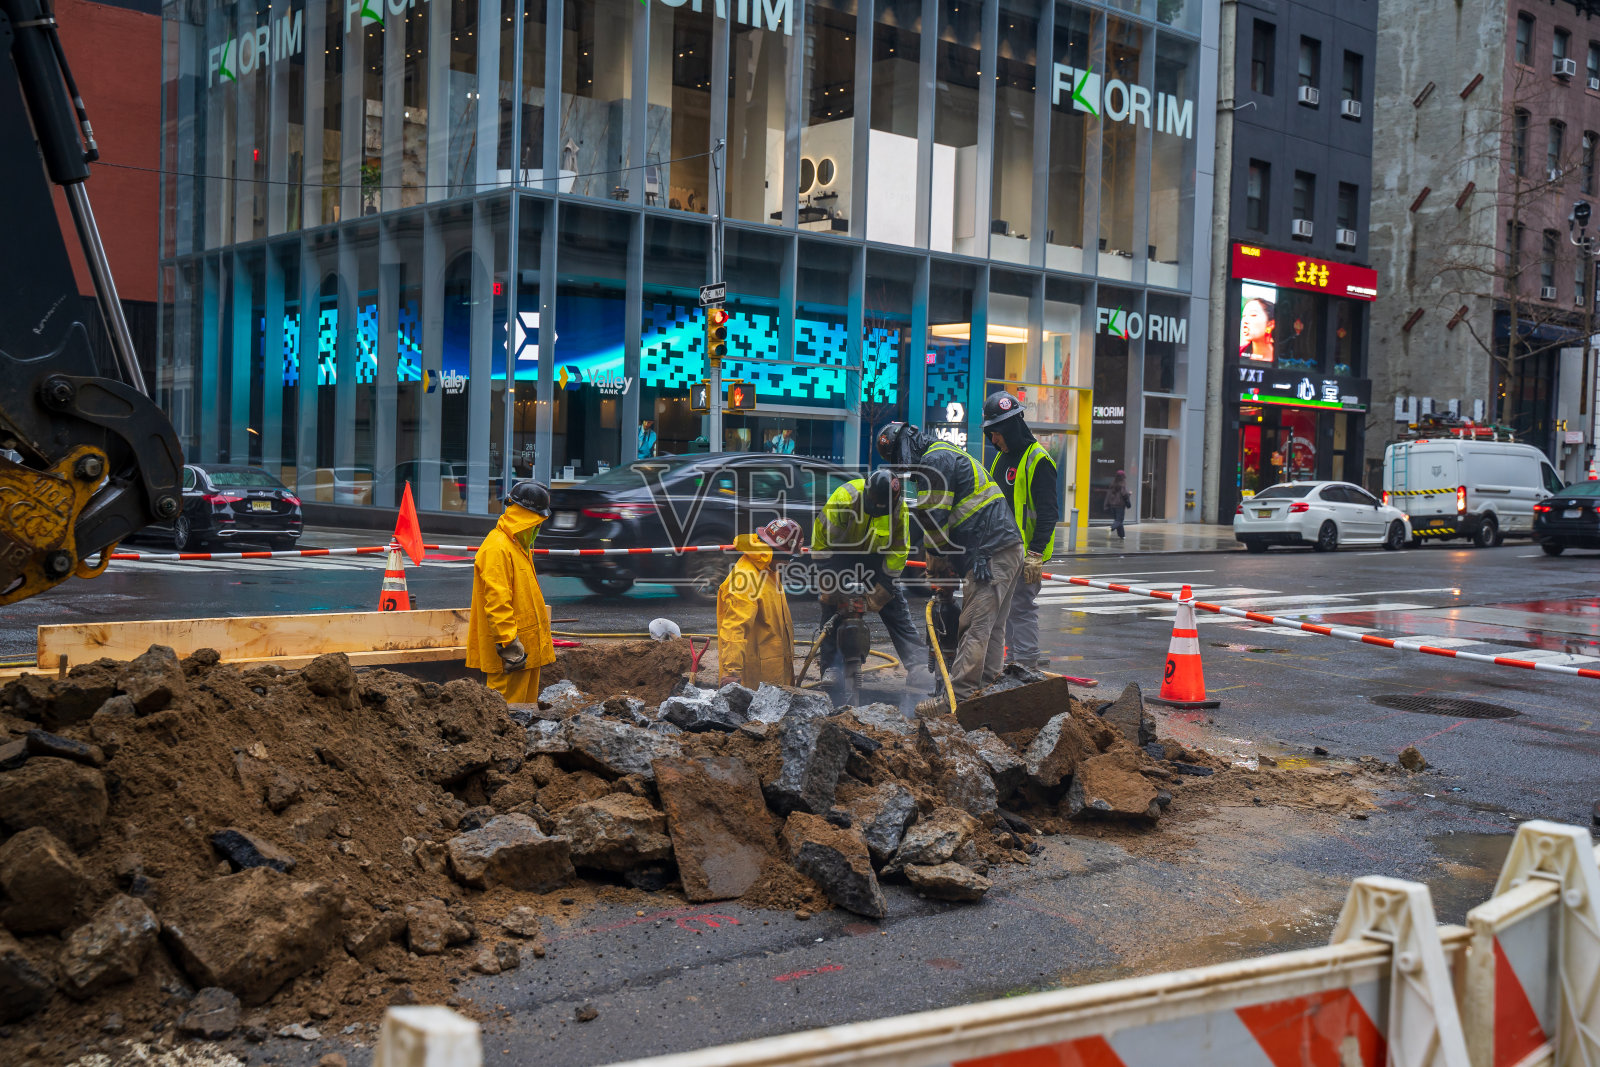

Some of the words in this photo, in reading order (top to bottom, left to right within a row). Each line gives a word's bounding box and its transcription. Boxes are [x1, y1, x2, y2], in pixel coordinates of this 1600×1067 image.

[1295, 261, 1330, 287] 王老吉
[439, 370, 467, 394] Valley
[587, 369, 633, 394] Valley
